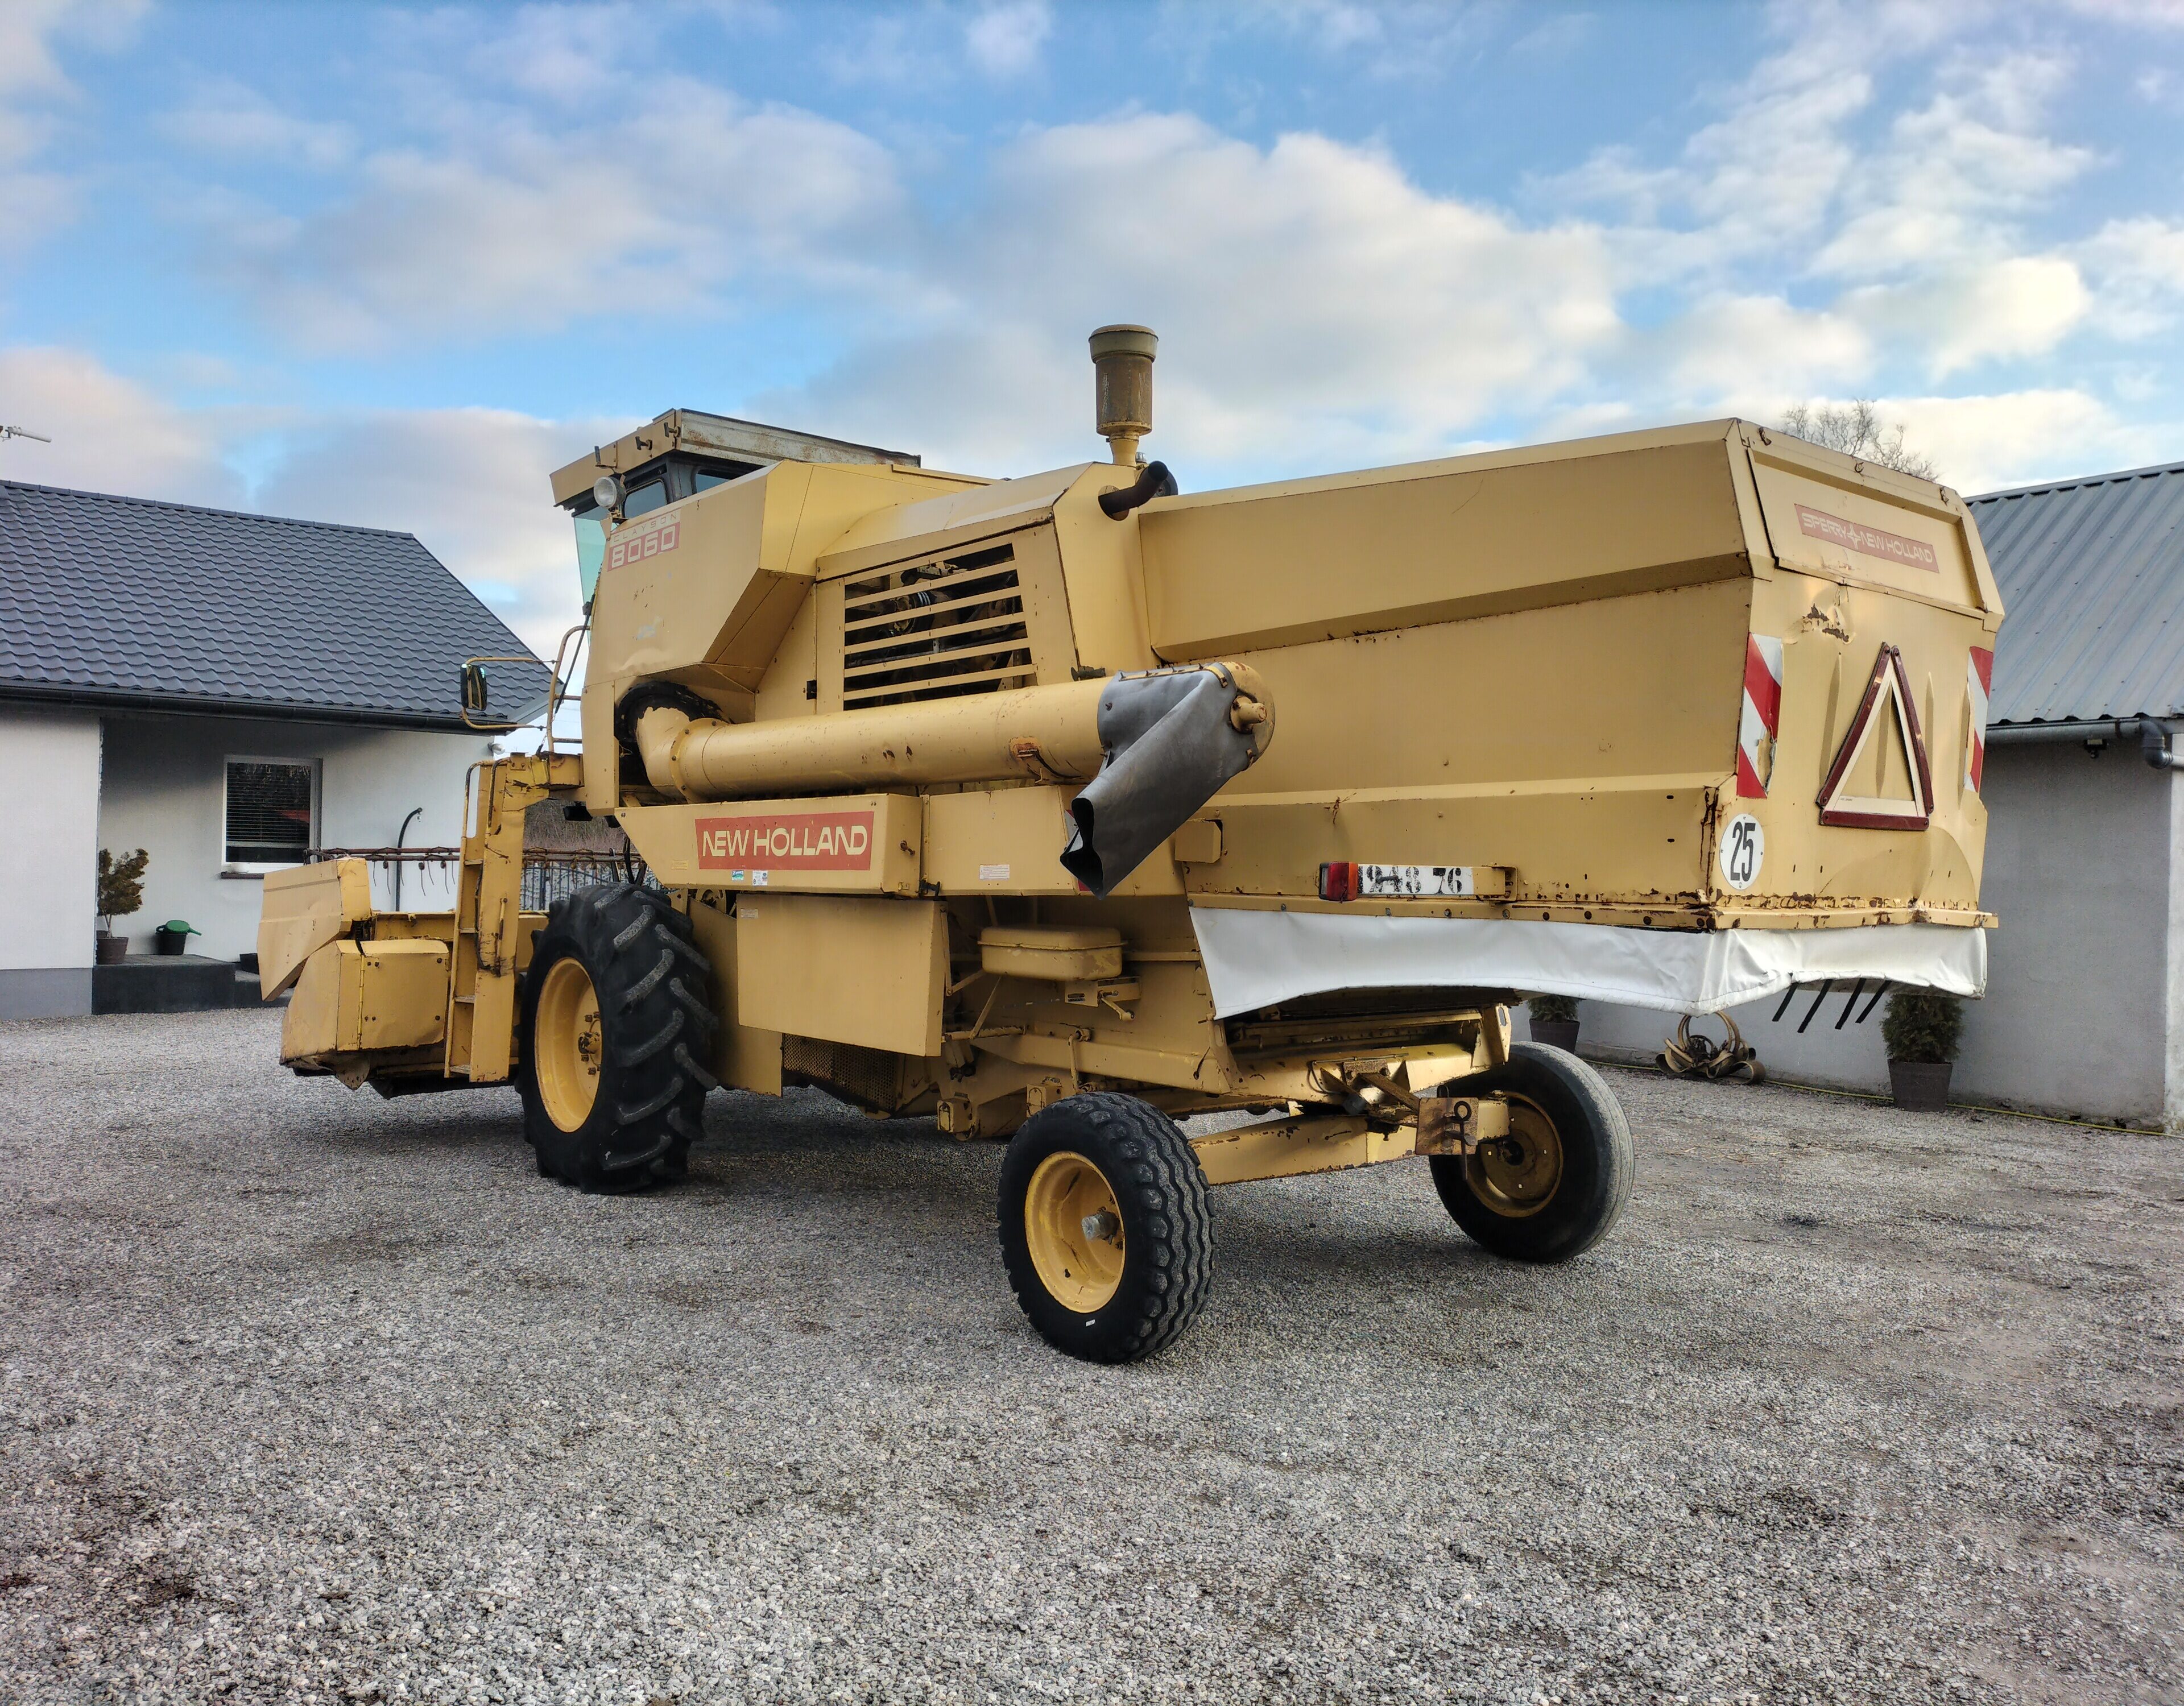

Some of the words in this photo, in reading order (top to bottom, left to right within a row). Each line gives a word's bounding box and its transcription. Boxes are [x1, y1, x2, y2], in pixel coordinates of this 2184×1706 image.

[614, 512, 677, 542] CLAYSON
[1801, 512, 1847, 538] SPERRY
[1860, 531, 1885, 550] NEW
[1886, 538, 1933, 563] HOLLAND
[611, 525, 676, 568] 8060
[702, 829, 750, 856] NEW
[753, 825, 868, 856] HOLLAND
[1730, 821, 1756, 883] 25
[1432, 867, 1463, 895] 76
